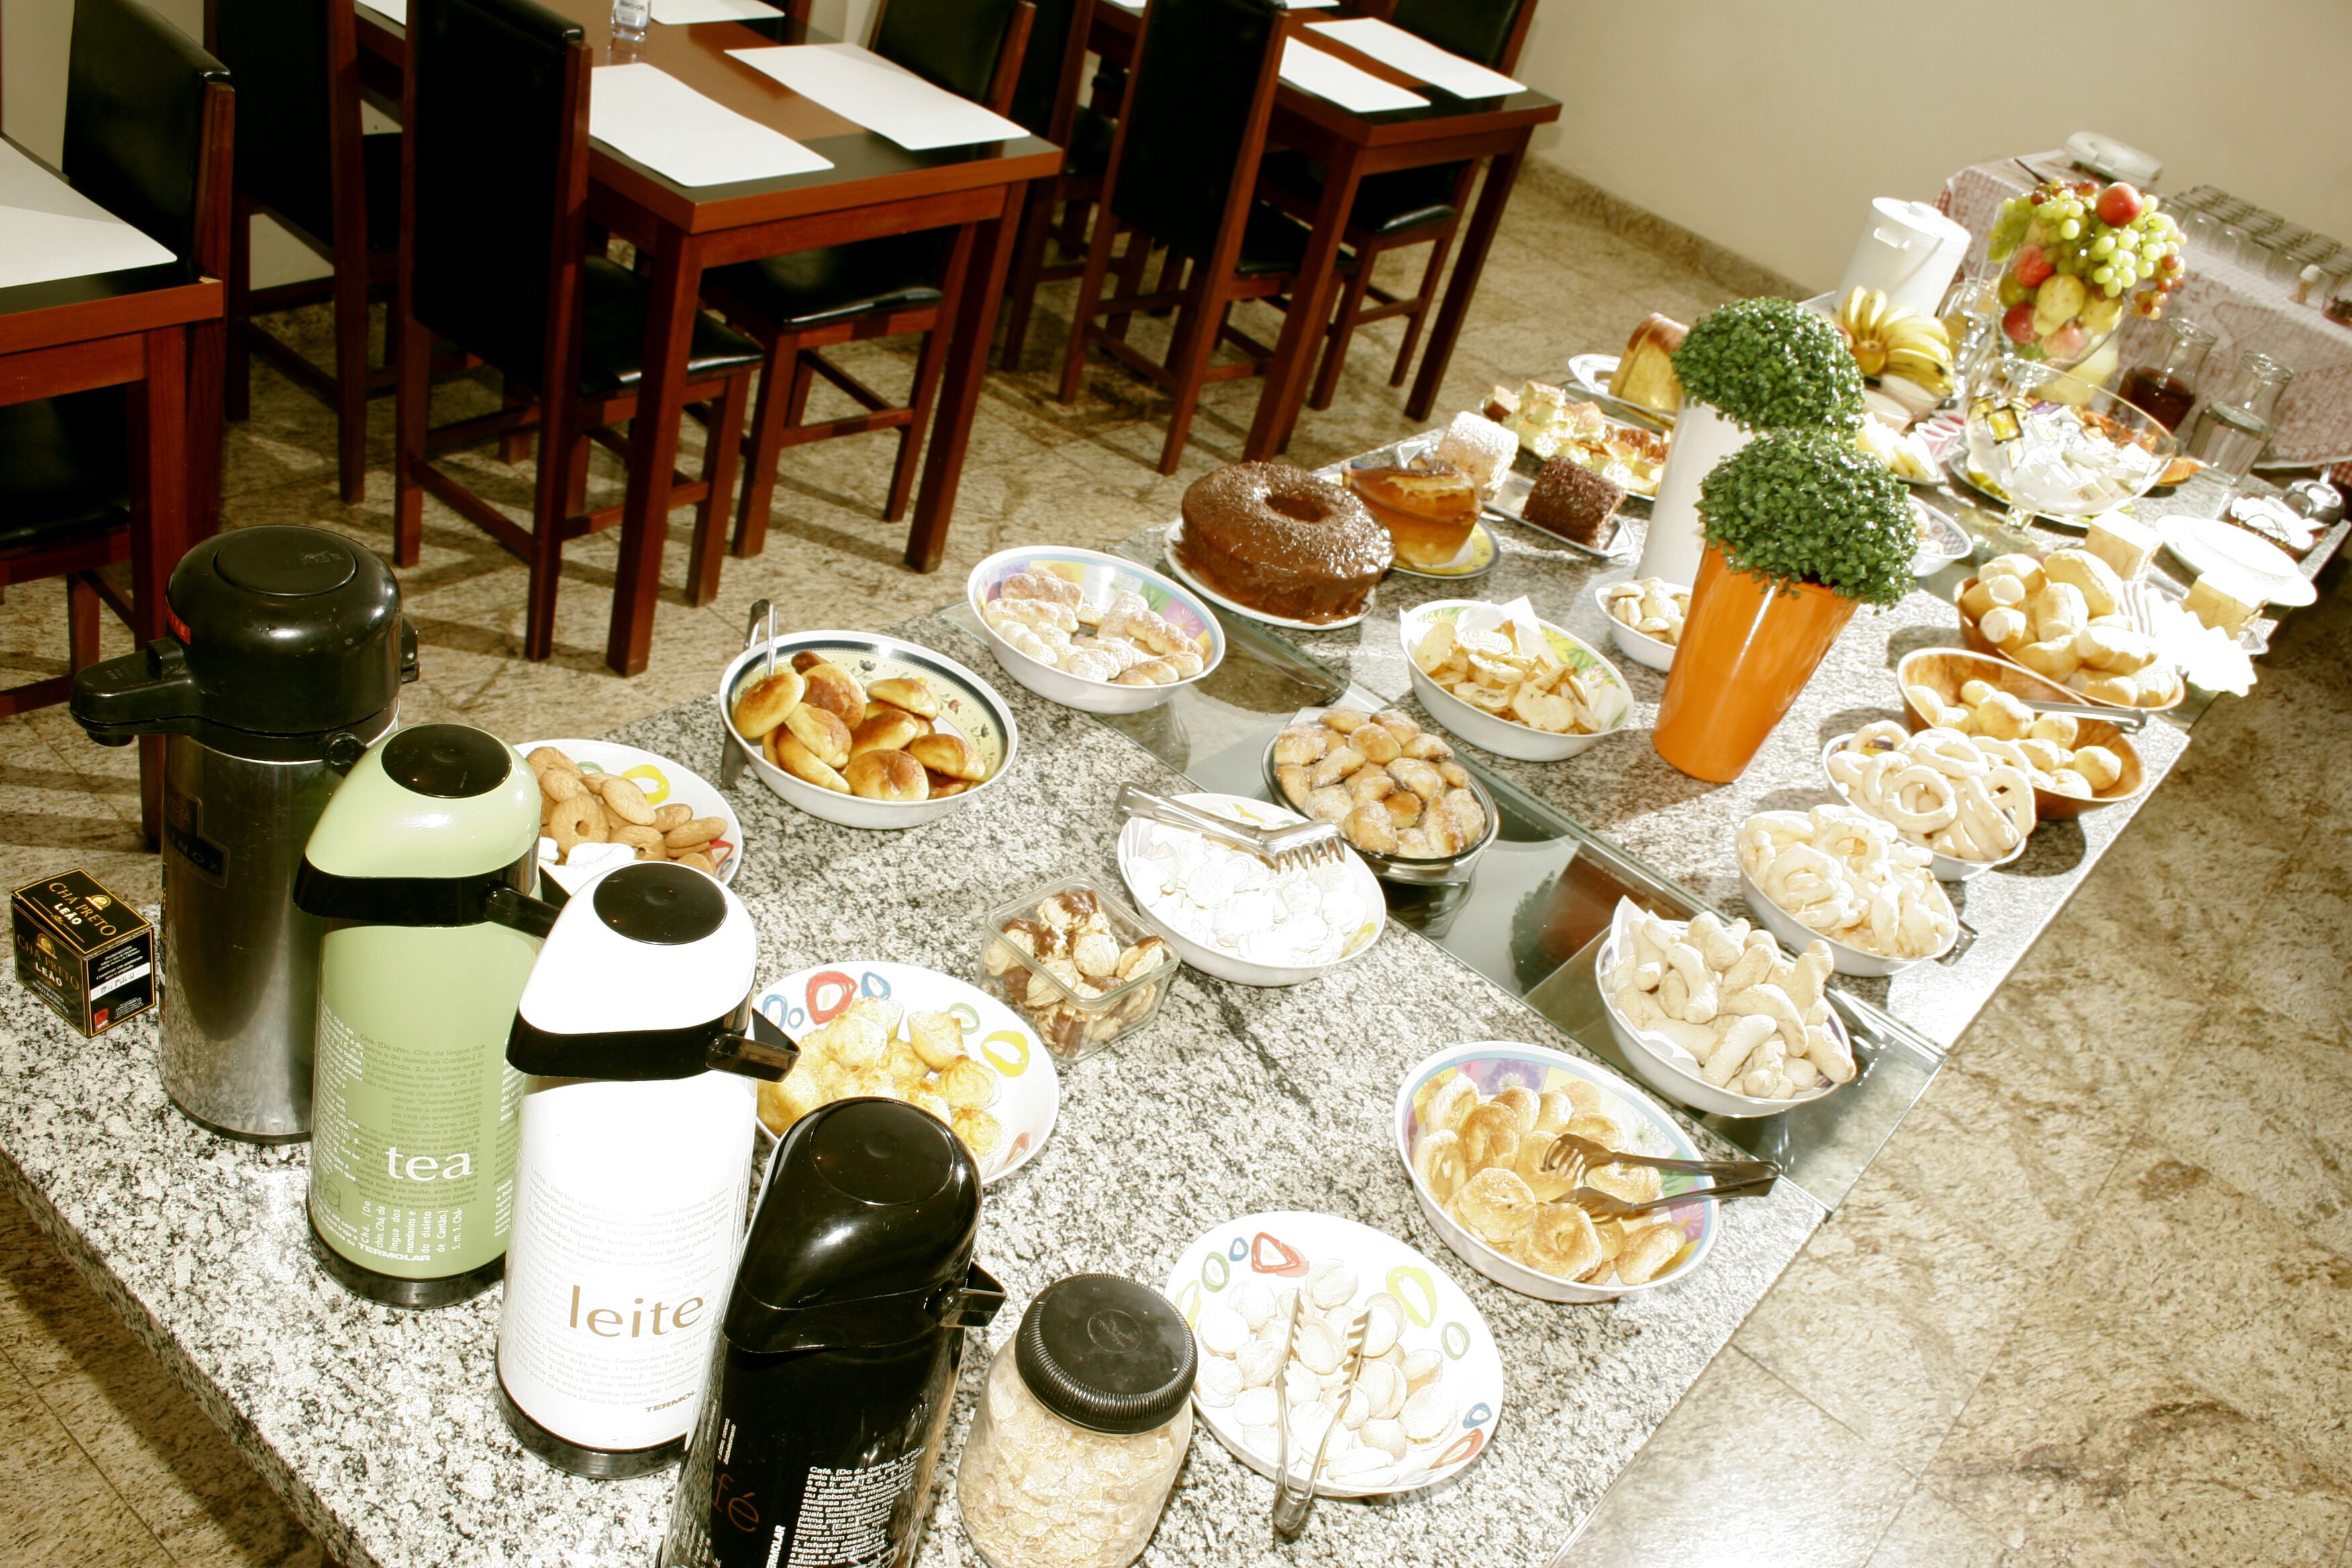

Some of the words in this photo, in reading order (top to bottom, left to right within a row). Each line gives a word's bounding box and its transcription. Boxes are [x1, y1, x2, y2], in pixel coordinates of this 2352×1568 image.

[49, 883, 79, 904] CHÁ
[76, 904, 116, 936] PRETO
[54, 903, 82, 925] LEÃO
[17, 935, 41, 961] CHÁ
[46, 957, 79, 990] PRETO
[35, 962, 62, 987] LEÃO
[446, 1048, 470, 1057] língua
[440, 1142, 462, 1150] tarde
[385, 1146, 473, 1181] tea
[356, 1175, 374, 1186] certa
[376, 1181, 394, 1191] hora
[454, 1183, 472, 1193] traje
[399, 1179, 418, 1187] hora
[467, 1173, 479, 1182] até
[354, 1180, 371, 1192] rigor
[373, 1189, 389, 1198] nem
[398, 1195, 438, 1203] exigência
[360, 1191, 404, 1208] servindo-se
[438, 1198, 471, 1208] bebidas
[376, 1206, 386, 1215] da
[390, 1209, 401, 1222] dos
[421, 1211, 432, 1238] dialeto
[534, 1201, 569, 1230] Qualquer
[570, 1226, 604, 1243] líquido
[389, 1228, 402, 1252] língua
[405, 1218, 416, 1254] mandarins
[359, 1242, 431, 1261] TERMOLAR
[420, 1244, 430, 1254] do
[436, 1243, 446, 1253] de
[577, 1240, 603, 1253] Leite
[569, 1283, 704, 1338] leite
[548, 1373, 560, 1383] de
[562, 1380, 584, 1391] vaca
[555, 1387, 577, 1399] quais
[810, 1466, 834, 1475] Café.
[836, 1468, 852, 1476] [Do
[841, 1498, 867, 1507] polpa
[867, 1481, 906, 1501] adocicada
[858, 1483, 897, 1498] vermelha,
[859, 1482, 883, 1492] drupa
[825, 1503, 863, 1513] grandes
[863, 1490, 902, 1508] sementes,
[797, 1516, 824, 1524] prima
[854, 1508, 888, 1522] preparo
[799, 1510, 824, 1518] quais
[826, 1507, 873, 1518] constituem
[832, 1525, 869, 1536] torradas,
[791, 1546, 824, 1554] depois
[840, 1540, 873, 1553] torrado
[841, 1535, 870, 1547] desse
[788, 1558, 833, 1566] adiciona
[798, 1554, 817, 1563] que
